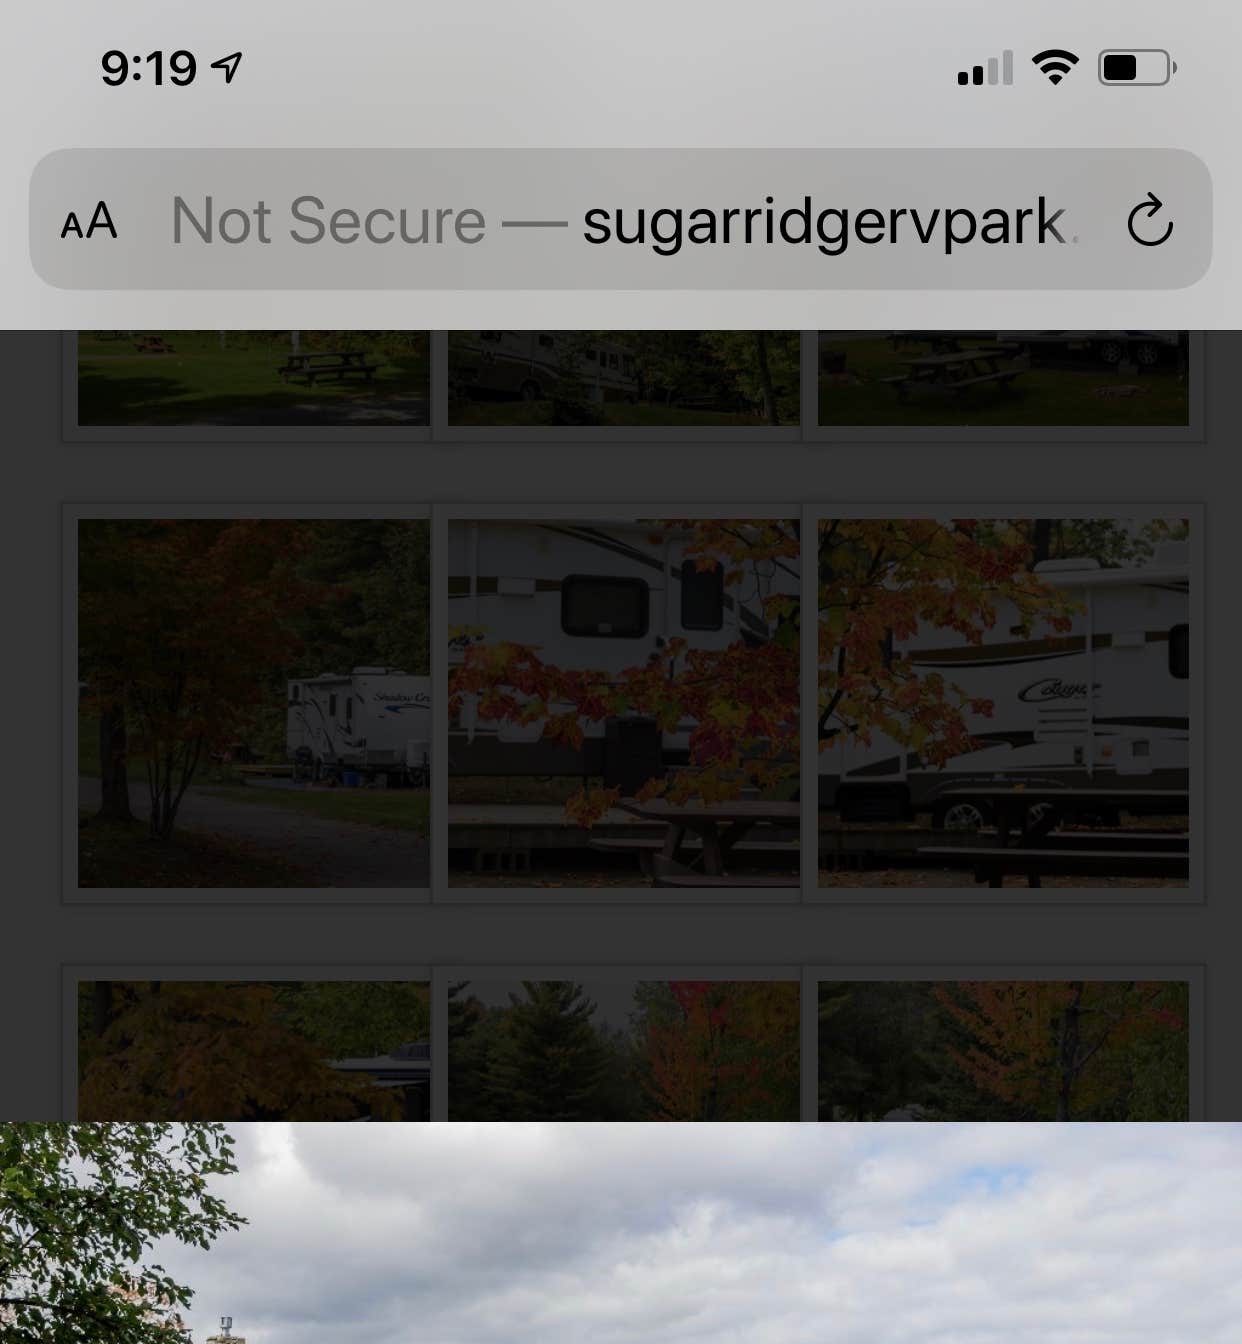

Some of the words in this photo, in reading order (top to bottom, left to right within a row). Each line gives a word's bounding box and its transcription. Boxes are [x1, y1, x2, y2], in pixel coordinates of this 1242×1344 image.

[102, 50, 197, 87] 9:19
[173, 195, 272, 245] Not
[289, 195, 486, 245] Secure
